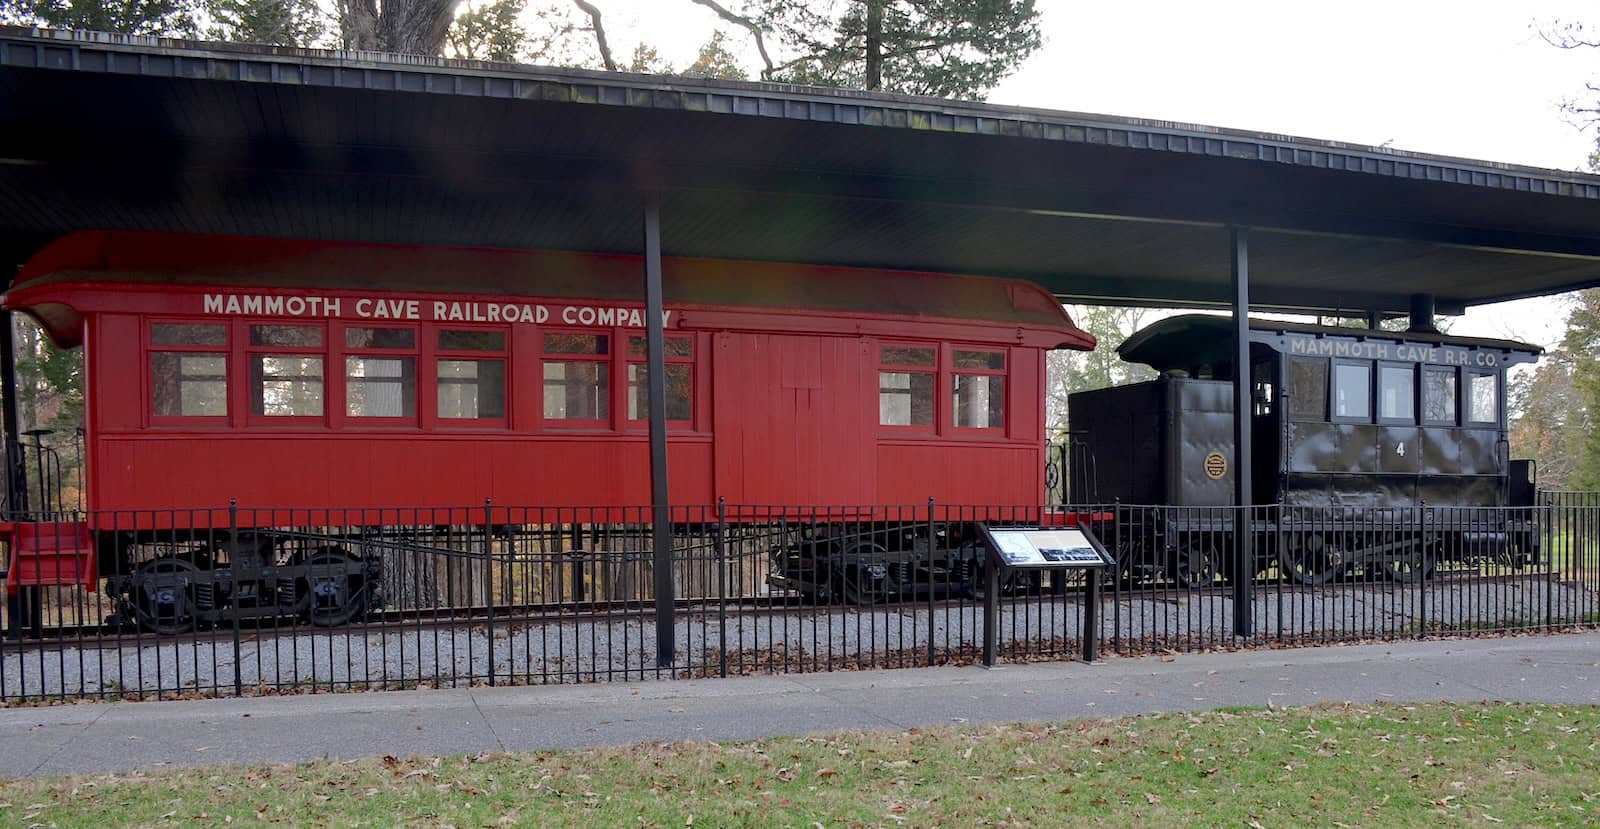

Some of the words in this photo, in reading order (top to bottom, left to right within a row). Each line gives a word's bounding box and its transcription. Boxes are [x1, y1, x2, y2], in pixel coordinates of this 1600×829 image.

[203, 294, 341, 317] MAMMOTH
[356, 298, 420, 320] CAVE
[433, 301, 550, 323] RAILROAD
[562, 306, 671, 328] COMPAY
[1291, 338, 1388, 358] MAMMOTH
[1397, 346, 1437, 362] CAVE
[1446, 352, 1472, 366] R.R.
[1476, 353, 1499, 367] CO.
[1397, 442, 1405, 457] 4
